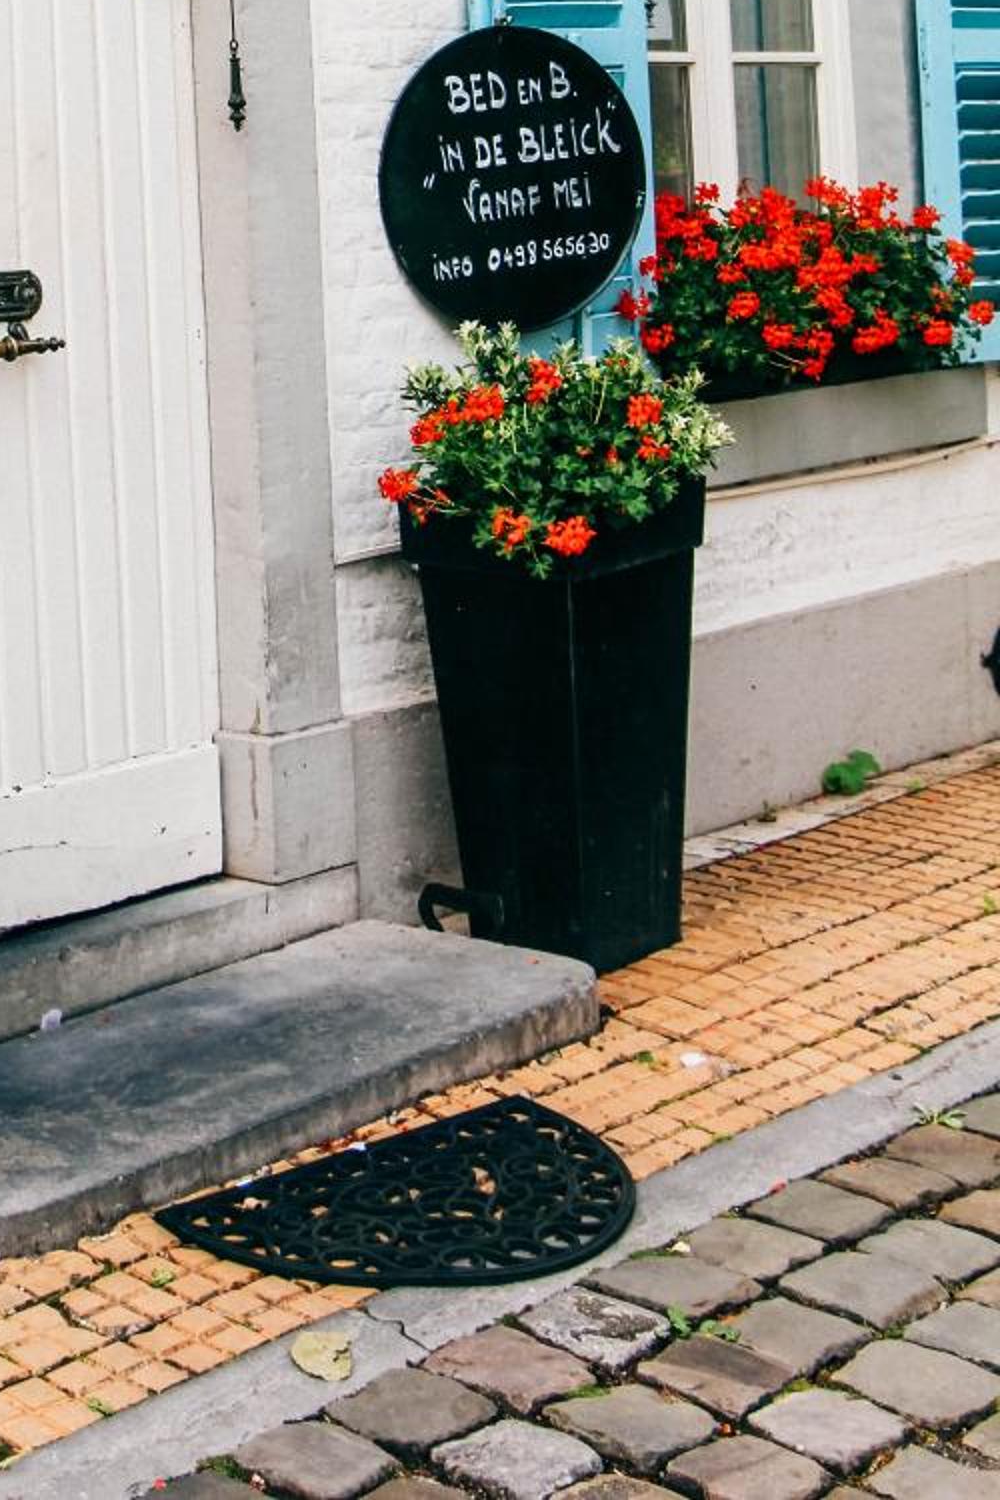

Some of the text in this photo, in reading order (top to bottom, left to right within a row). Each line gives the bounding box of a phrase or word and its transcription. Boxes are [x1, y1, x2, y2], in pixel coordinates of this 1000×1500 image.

[443, 70, 507, 114] BED
[474, 134, 507, 169] DE
[463, 177, 541, 224] VANAF
